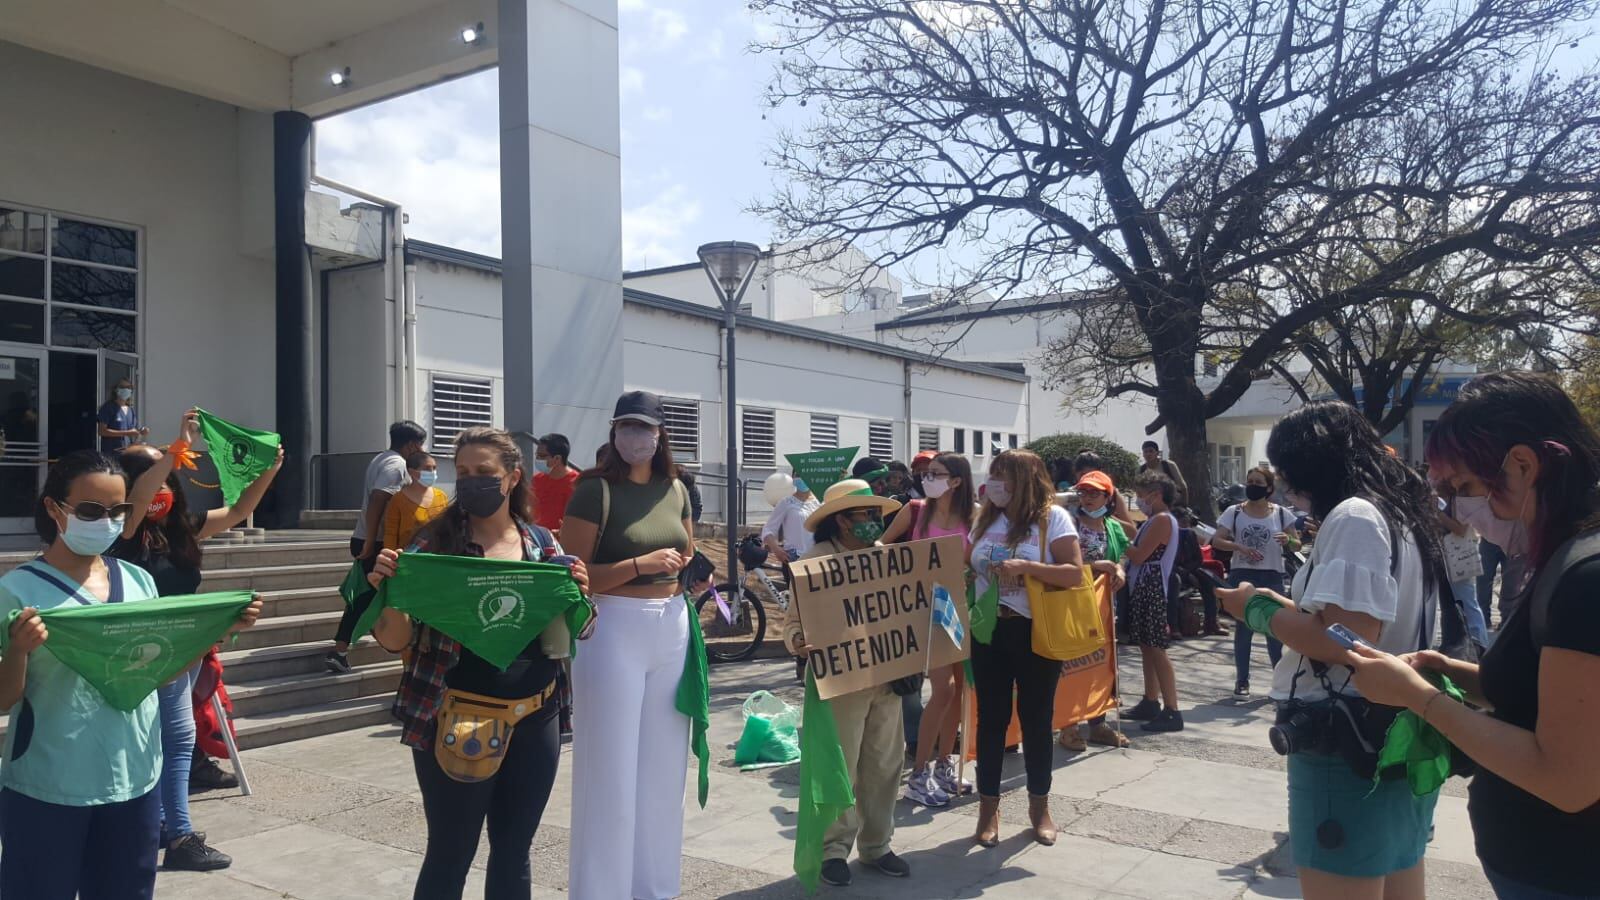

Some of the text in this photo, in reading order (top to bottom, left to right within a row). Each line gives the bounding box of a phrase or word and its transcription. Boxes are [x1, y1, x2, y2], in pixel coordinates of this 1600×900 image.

[804, 542, 942, 592] LIBERTAD A
[843, 580, 929, 628] MEDICA
[808, 624, 919, 680] DETENIDA
